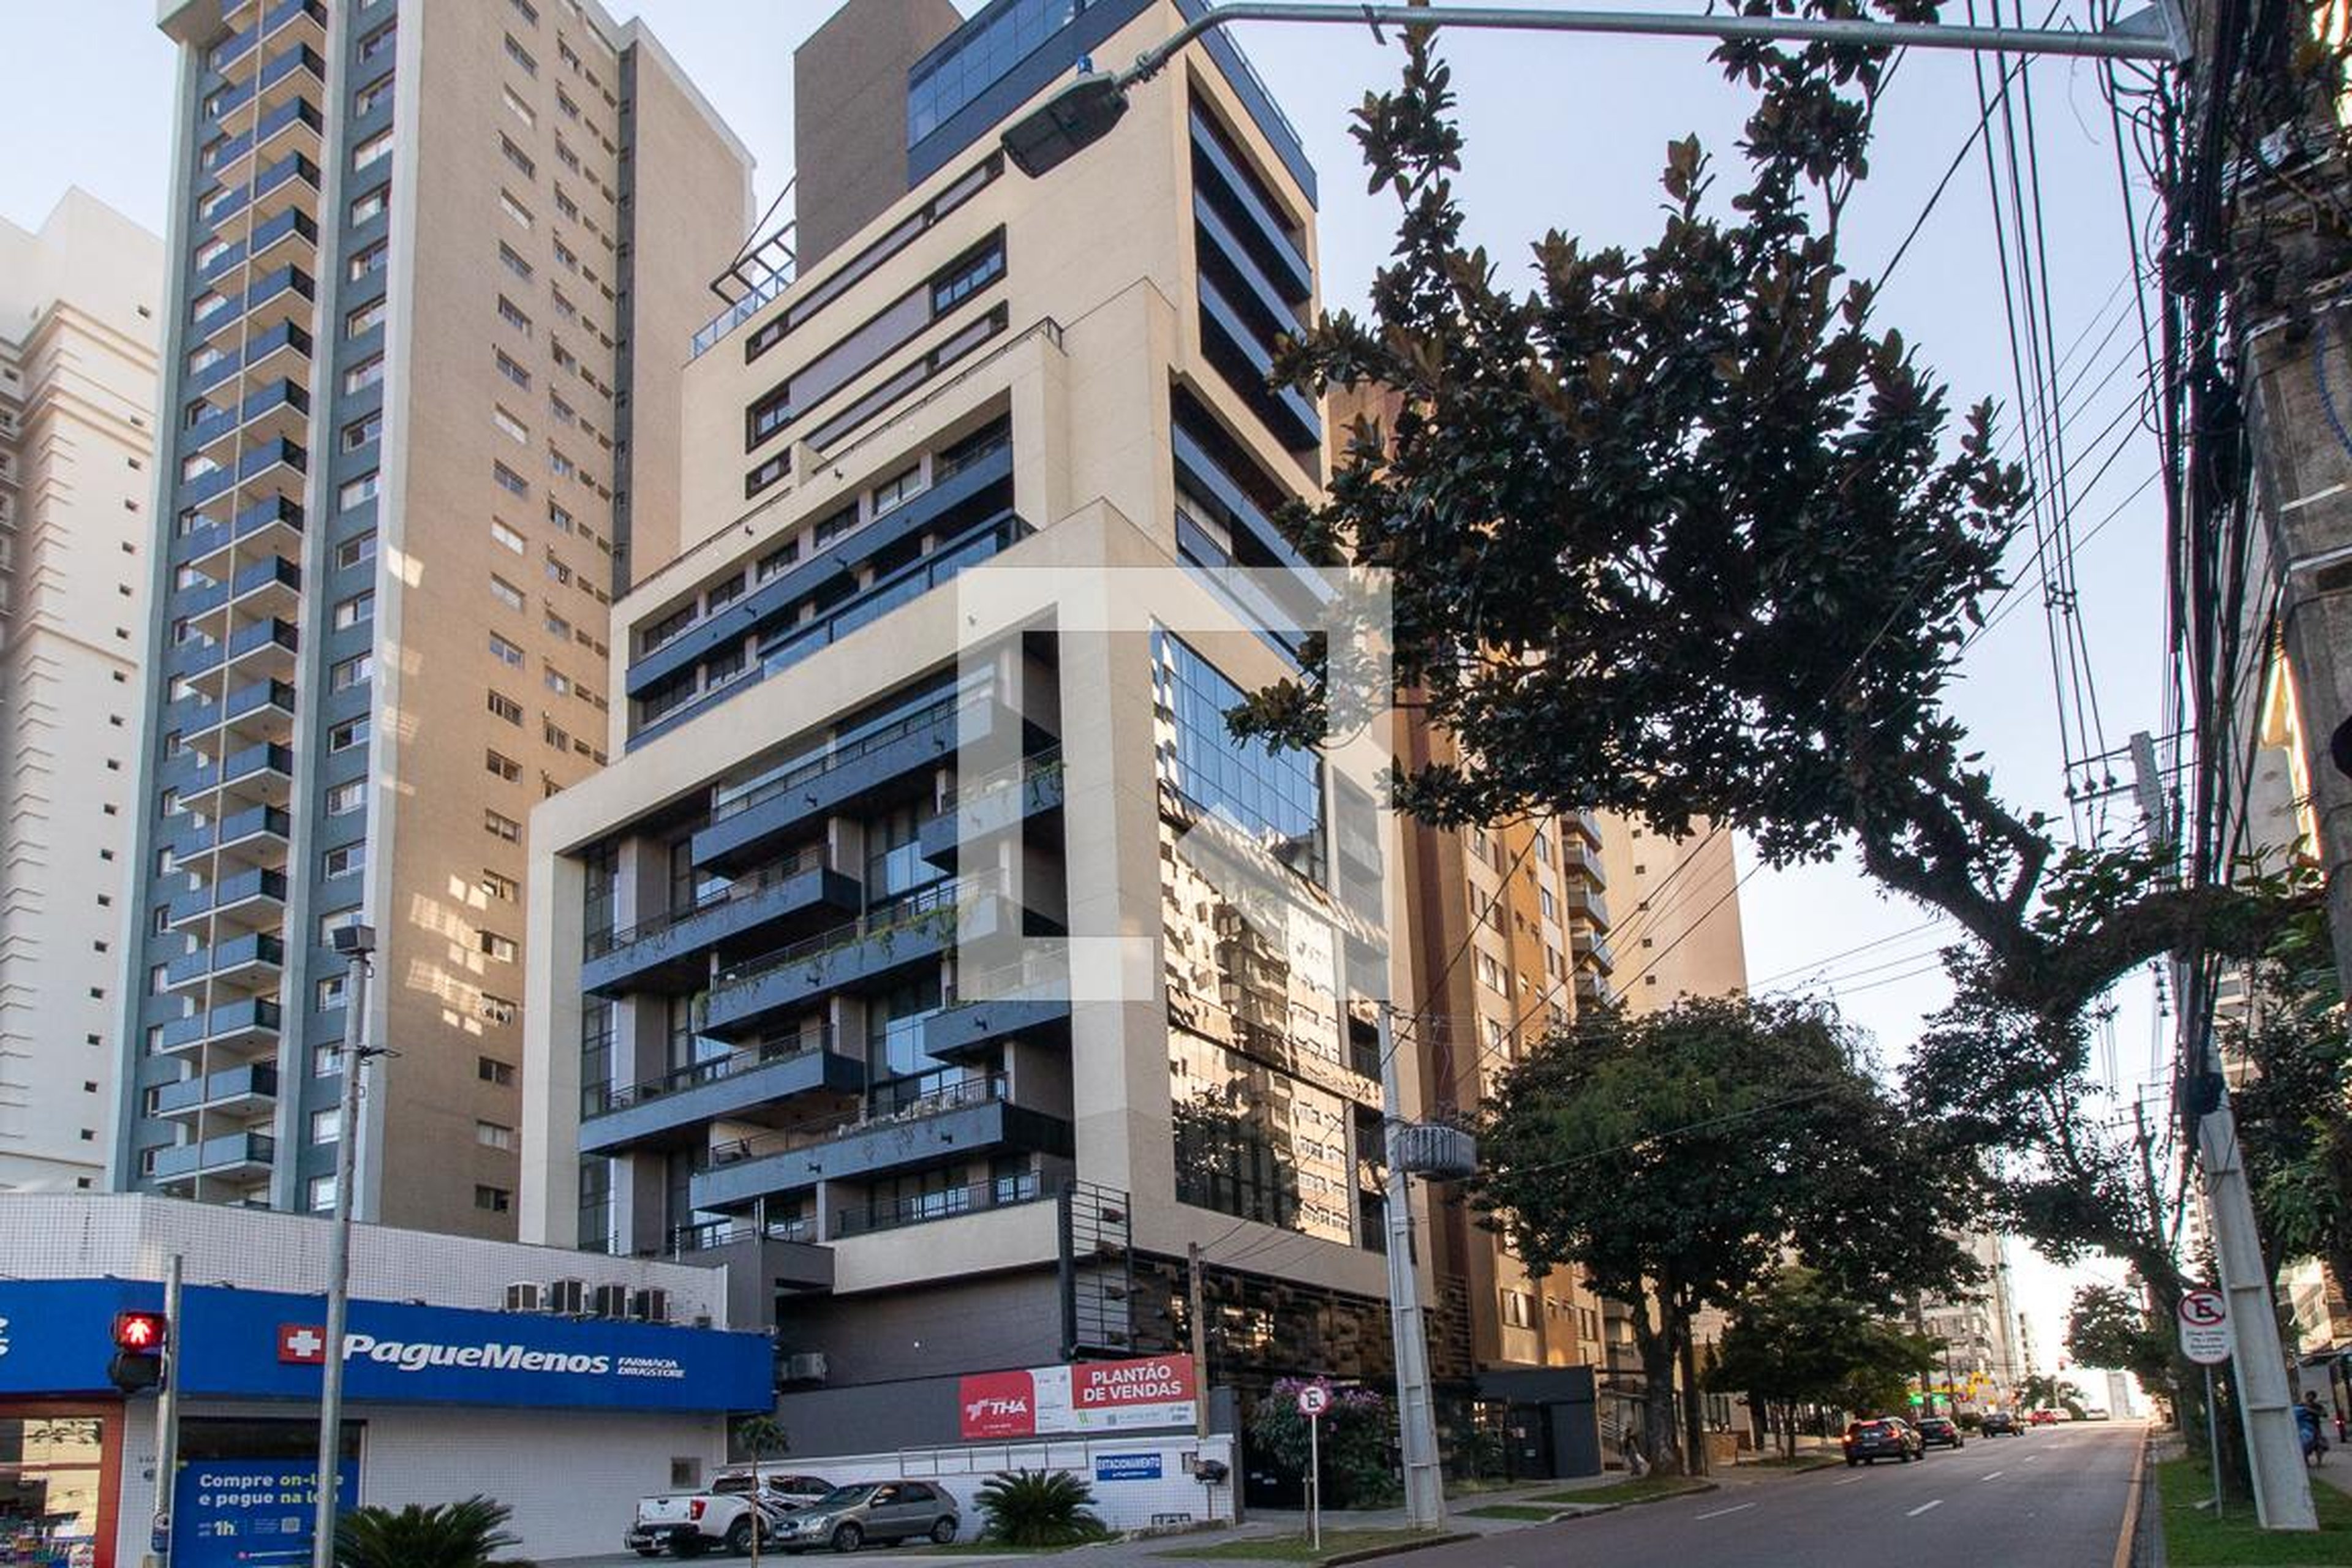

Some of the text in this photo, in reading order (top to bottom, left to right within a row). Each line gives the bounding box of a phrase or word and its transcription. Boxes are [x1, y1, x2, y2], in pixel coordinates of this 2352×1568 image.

[343, 1334, 609, 1373] PagueMenos
[1091, 1362, 1171, 1386] PLANTÃO
[1083, 1381, 1182, 1402] DE VENDAS
[199, 1473, 274, 1490] Compre
[198, 1493, 211, 1506] e
[215, 1493, 274, 1507] pegue
[280, 1493, 301, 1504] na
